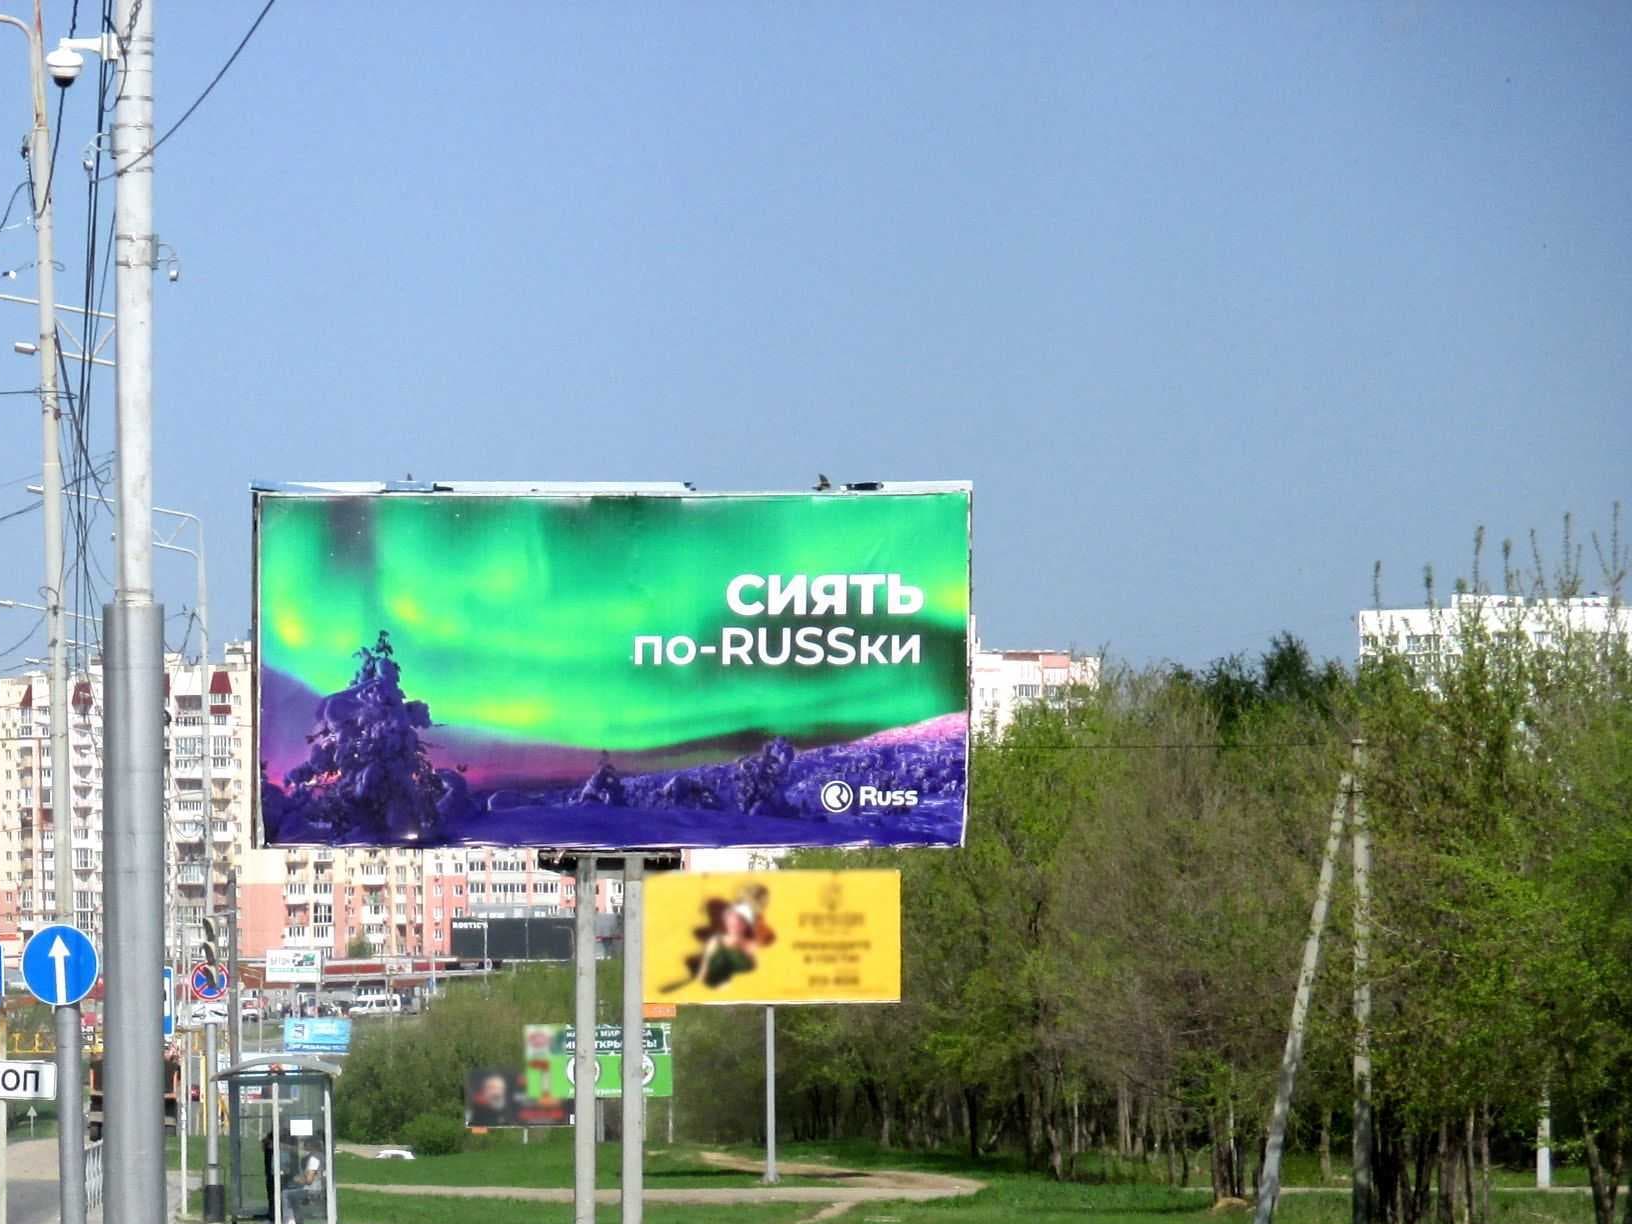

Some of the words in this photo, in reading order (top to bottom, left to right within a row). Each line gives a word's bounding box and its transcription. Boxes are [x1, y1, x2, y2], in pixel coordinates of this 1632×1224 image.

[726, 574, 924, 616] СИЯТЬ
[633, 626, 921, 666] по-RUSSки
[859, 786, 919, 806] Russ
